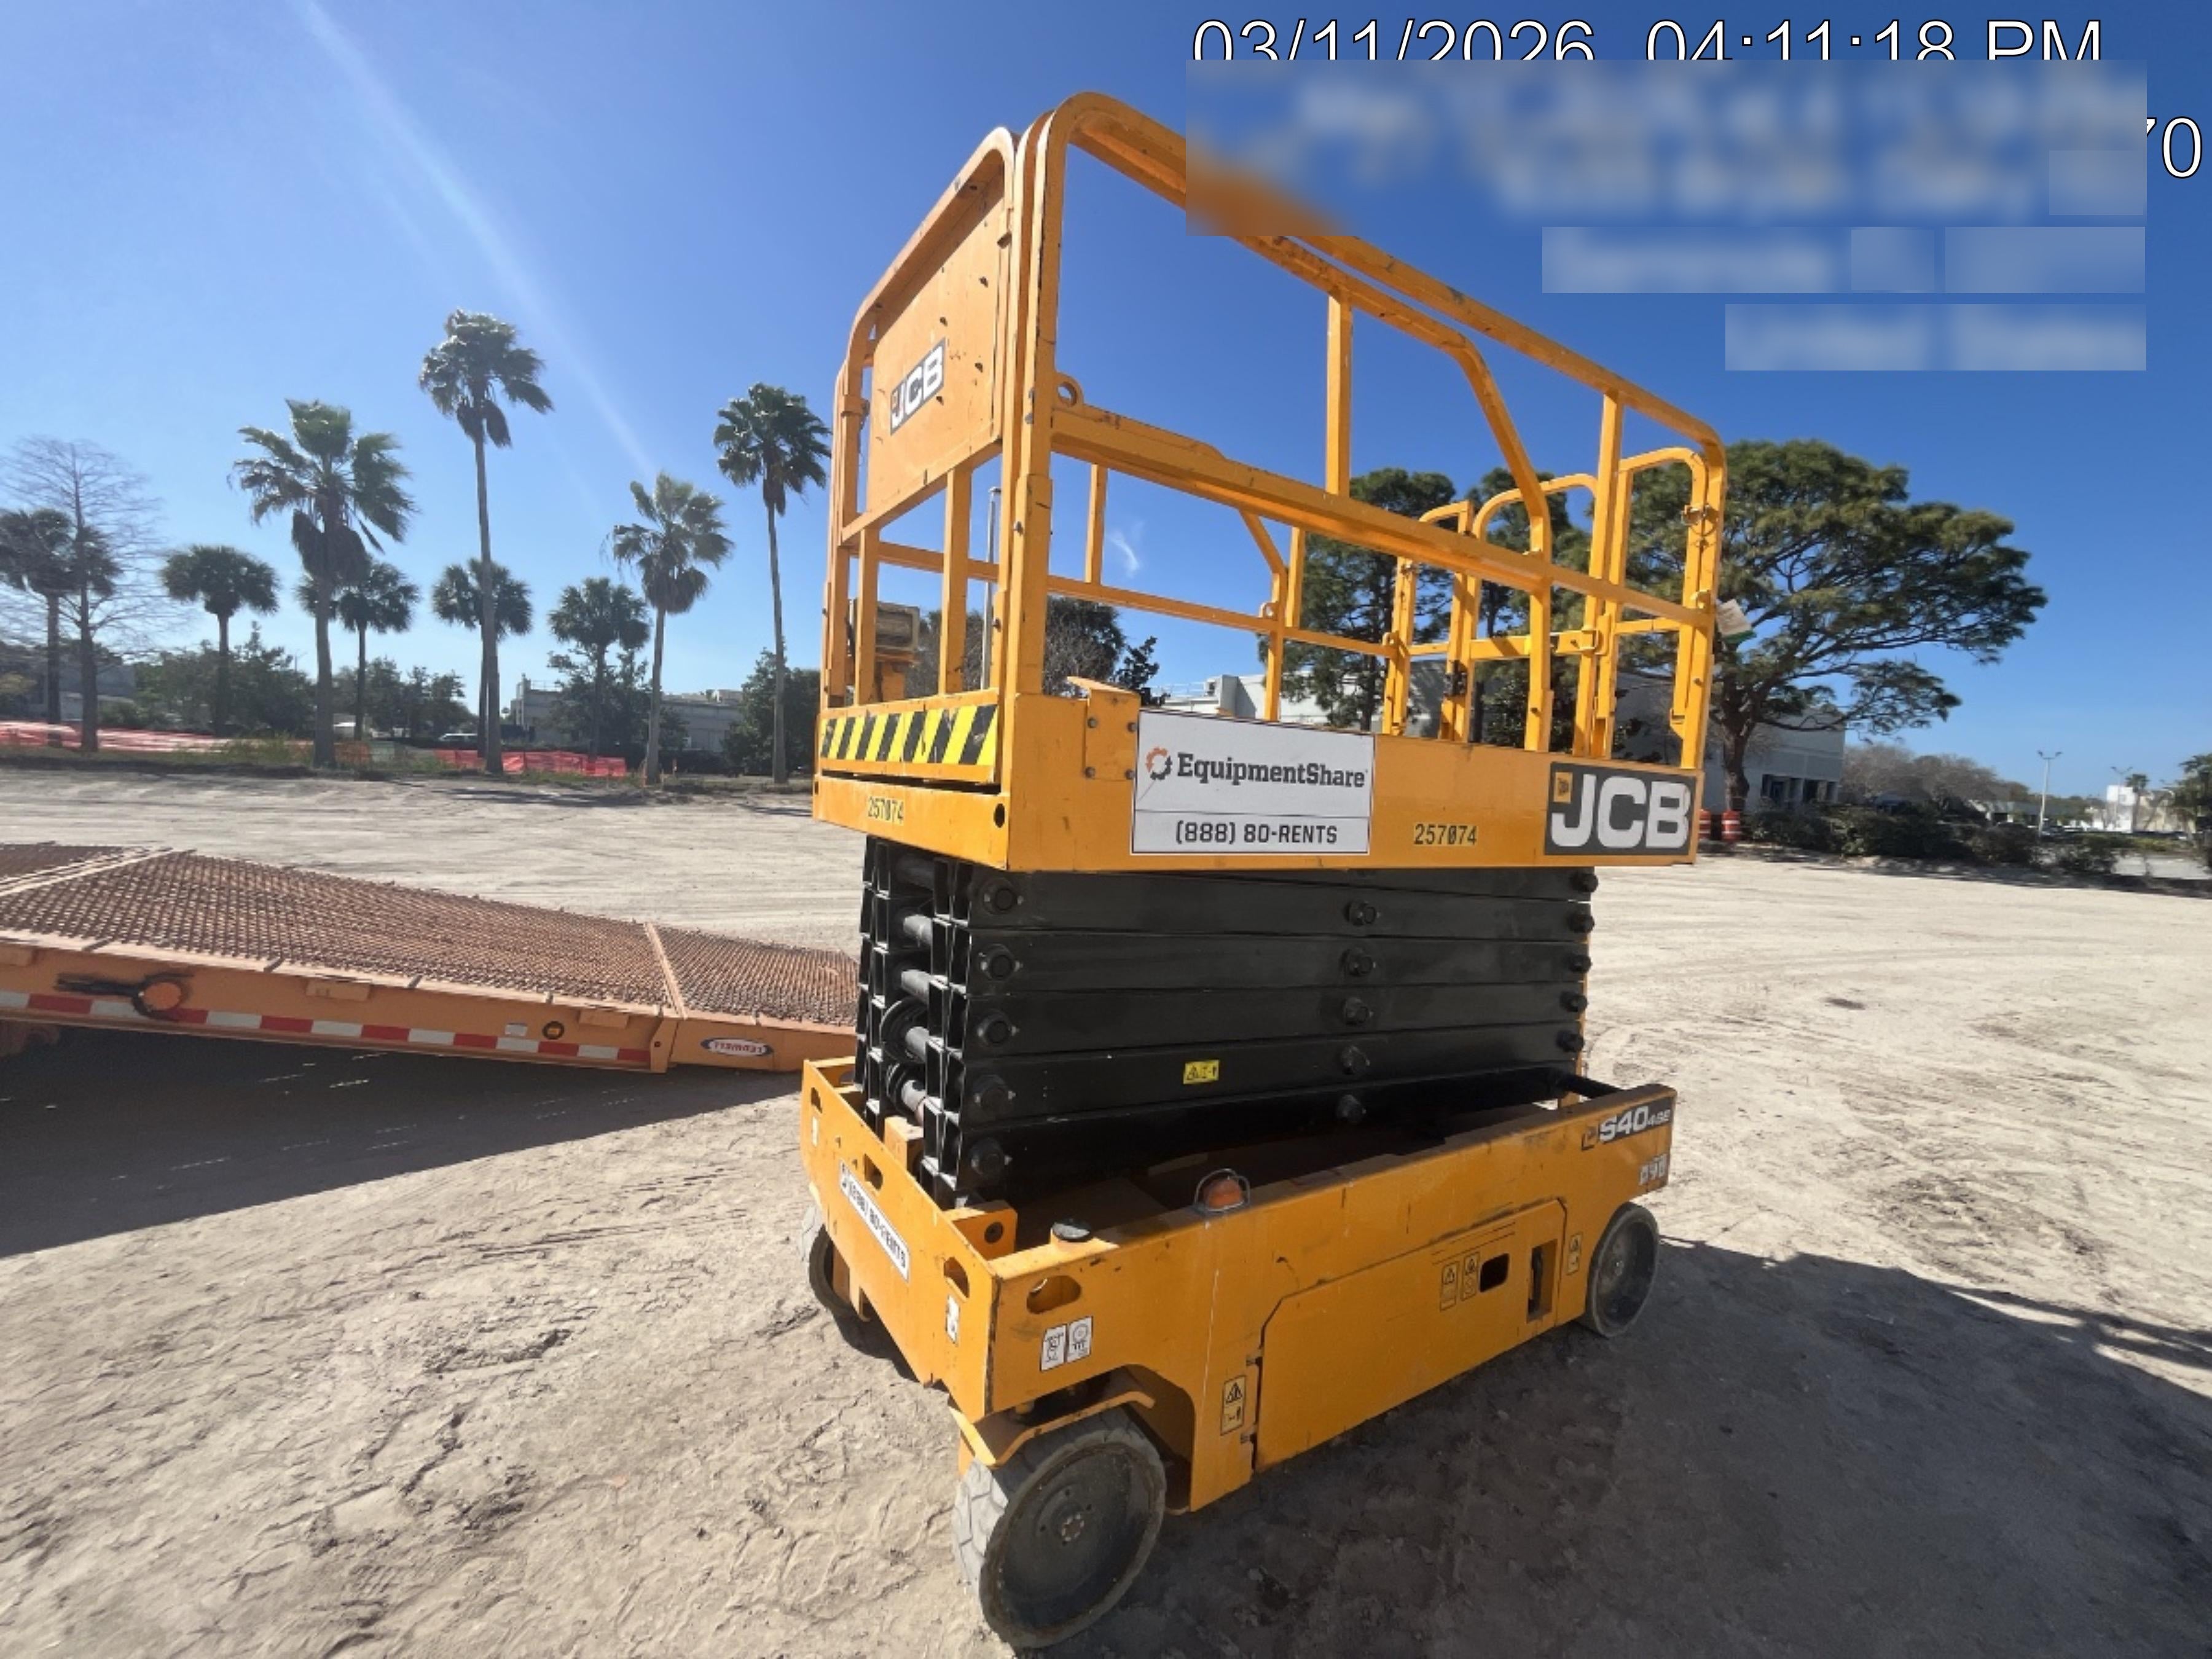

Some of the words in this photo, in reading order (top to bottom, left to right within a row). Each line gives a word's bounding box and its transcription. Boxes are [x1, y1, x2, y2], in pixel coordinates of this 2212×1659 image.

[891, 345, 943, 429] JCB
[1177, 751, 1365, 788] EquipmentShare
[867, 796, 904, 824] 257074
[1551, 773, 1690, 849] JCB
[1175, 820, 1236, 845] (888)
[1243, 823, 1338, 844] 80-RENTS
[1414, 823, 1477, 845] 257074
